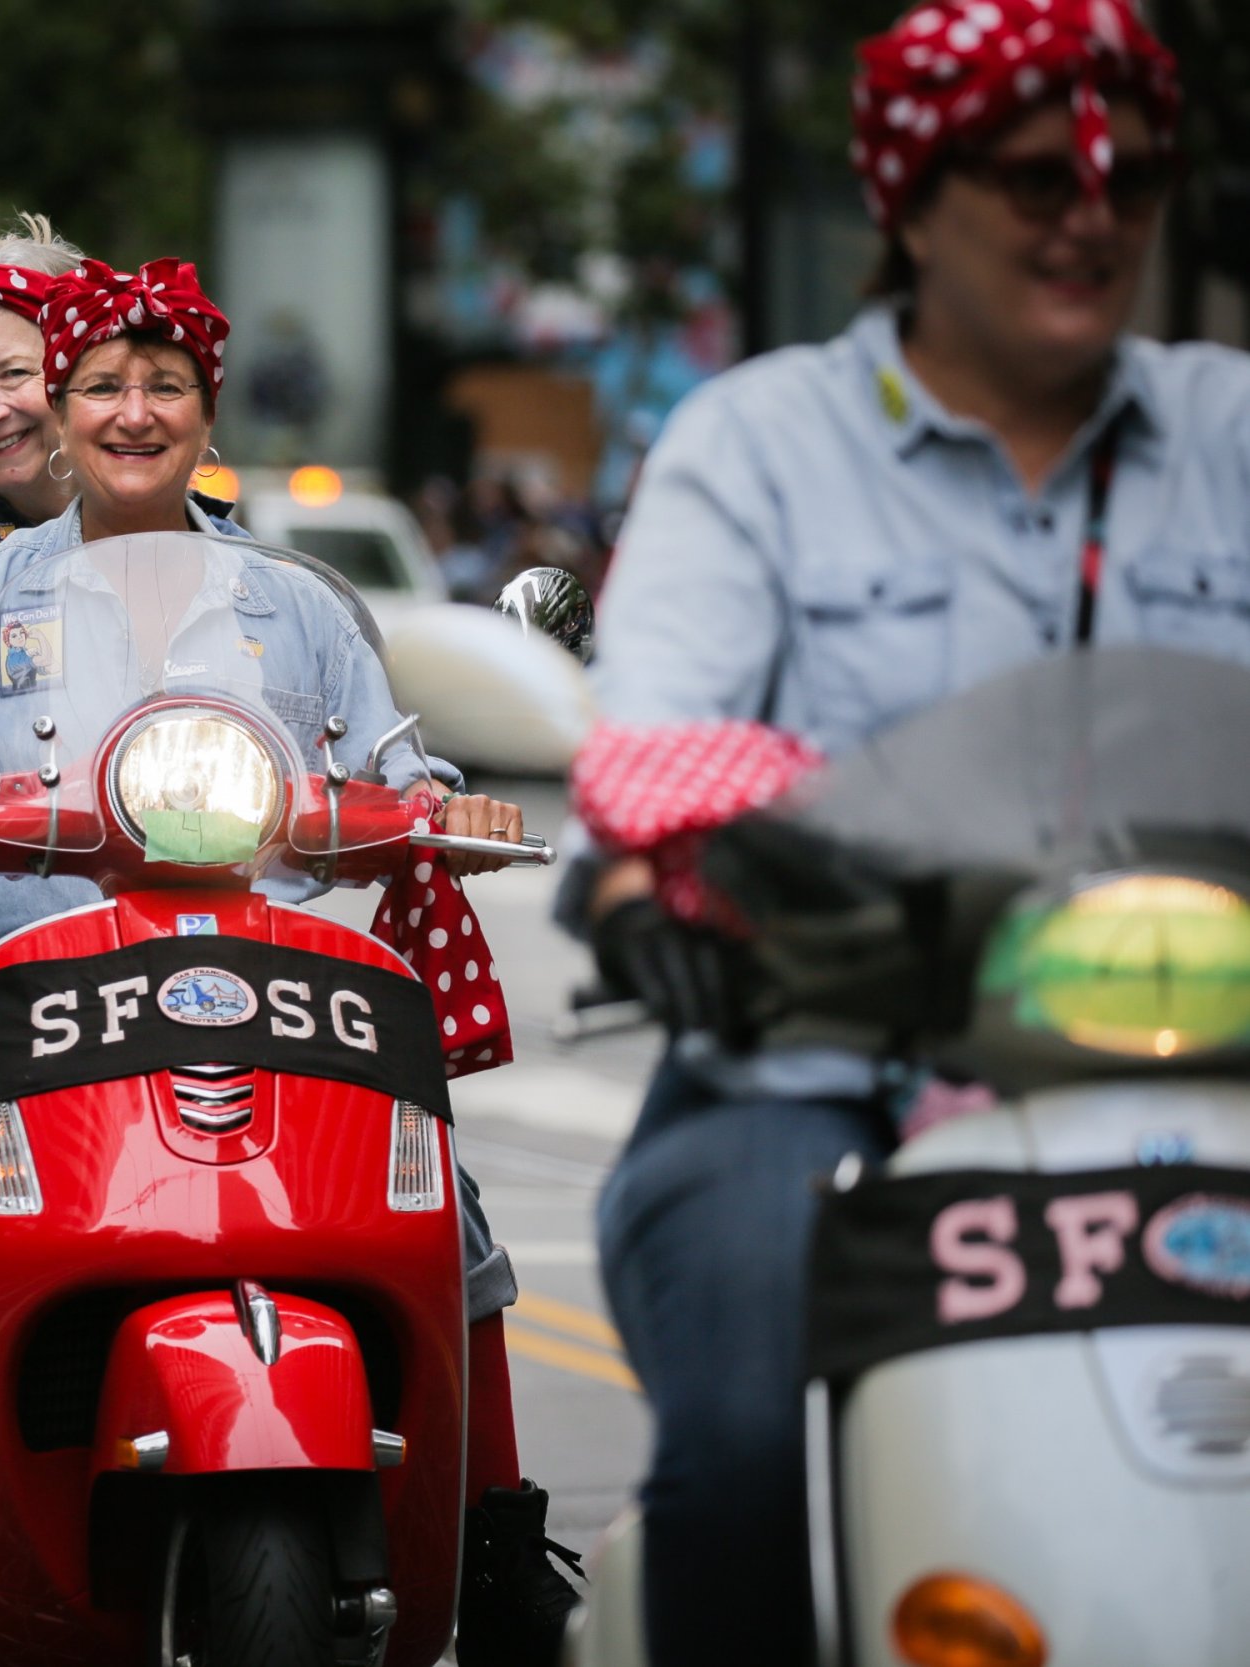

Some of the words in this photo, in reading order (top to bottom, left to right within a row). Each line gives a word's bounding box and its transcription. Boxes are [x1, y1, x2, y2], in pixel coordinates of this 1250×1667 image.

[2, 614, 17, 624] We
[18, 611, 35, 622] Can
[36, 609, 49, 619] Do
[164, 659, 207, 677] Vespa
[173, 972, 190, 981] SAN
[194, 969, 240, 984] FRANCISCO
